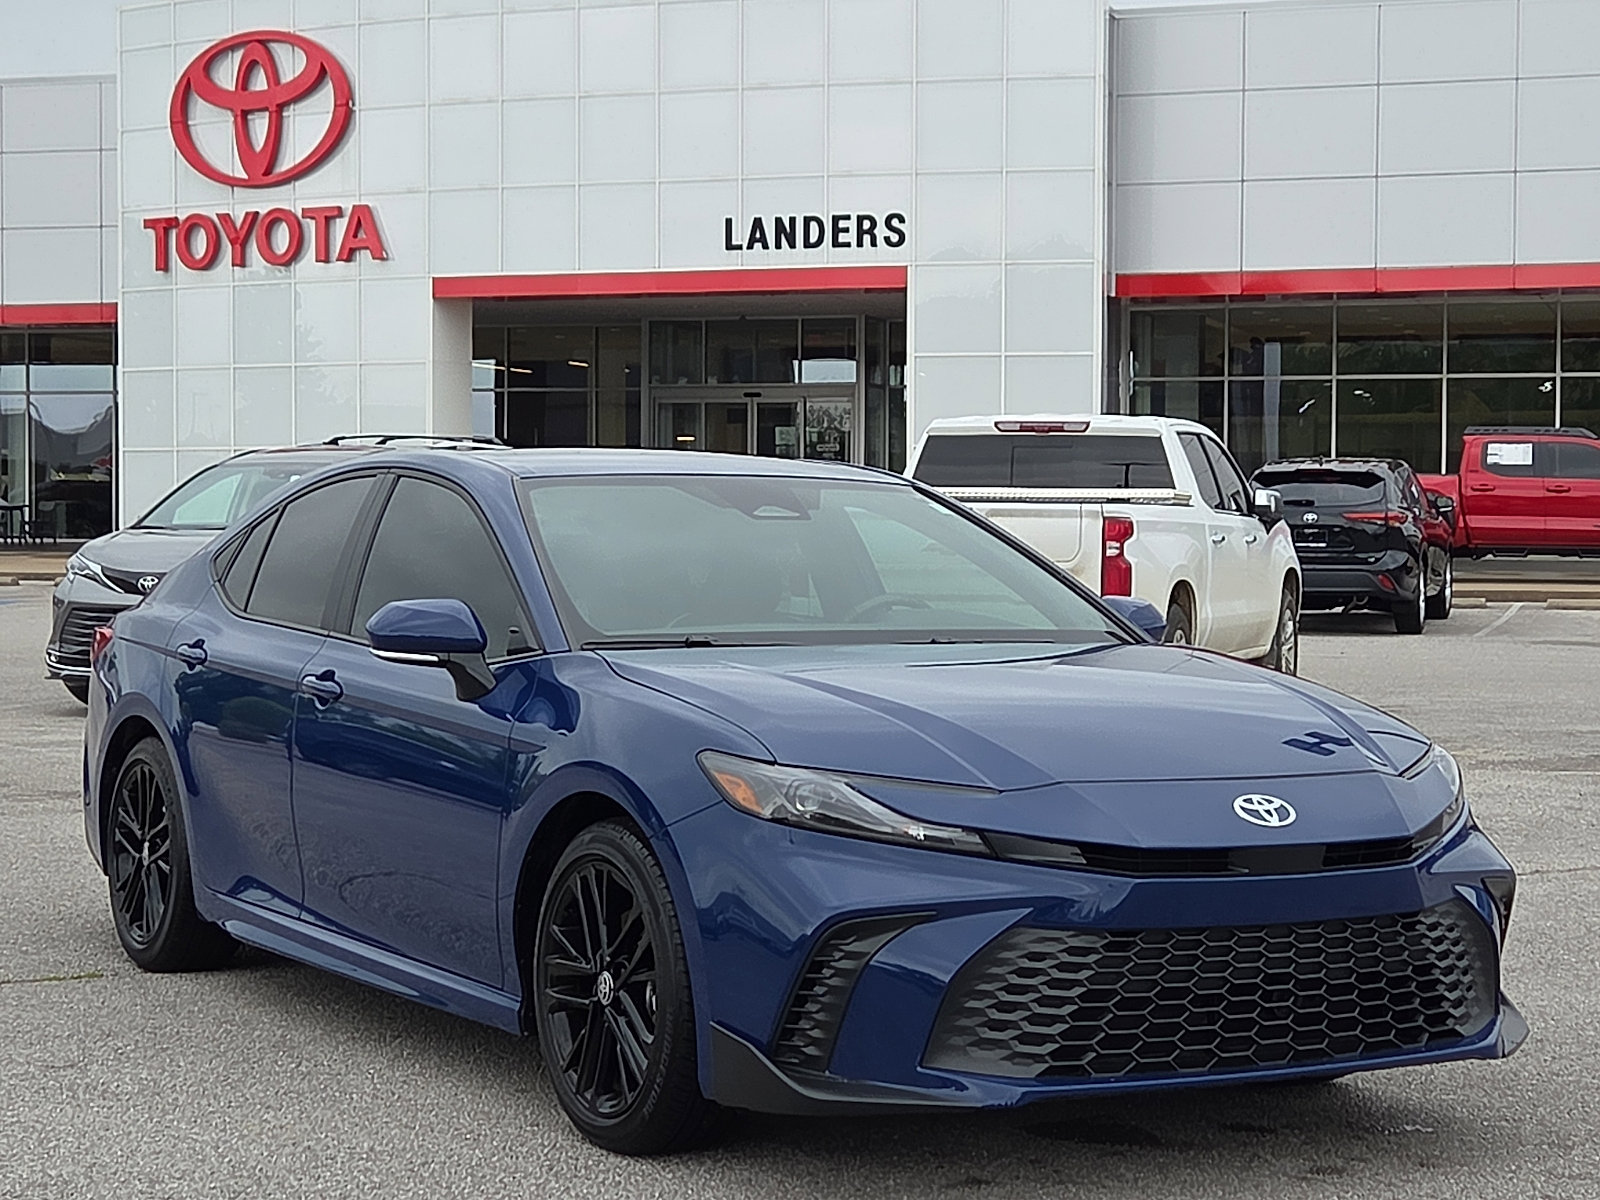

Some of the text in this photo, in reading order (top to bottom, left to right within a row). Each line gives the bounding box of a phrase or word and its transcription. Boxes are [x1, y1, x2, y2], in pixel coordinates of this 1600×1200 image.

[144, 204, 387, 272] TOYOTA
[725, 212, 907, 251] LANDERS
[643, 1011, 673, 1119] IDGESTON
